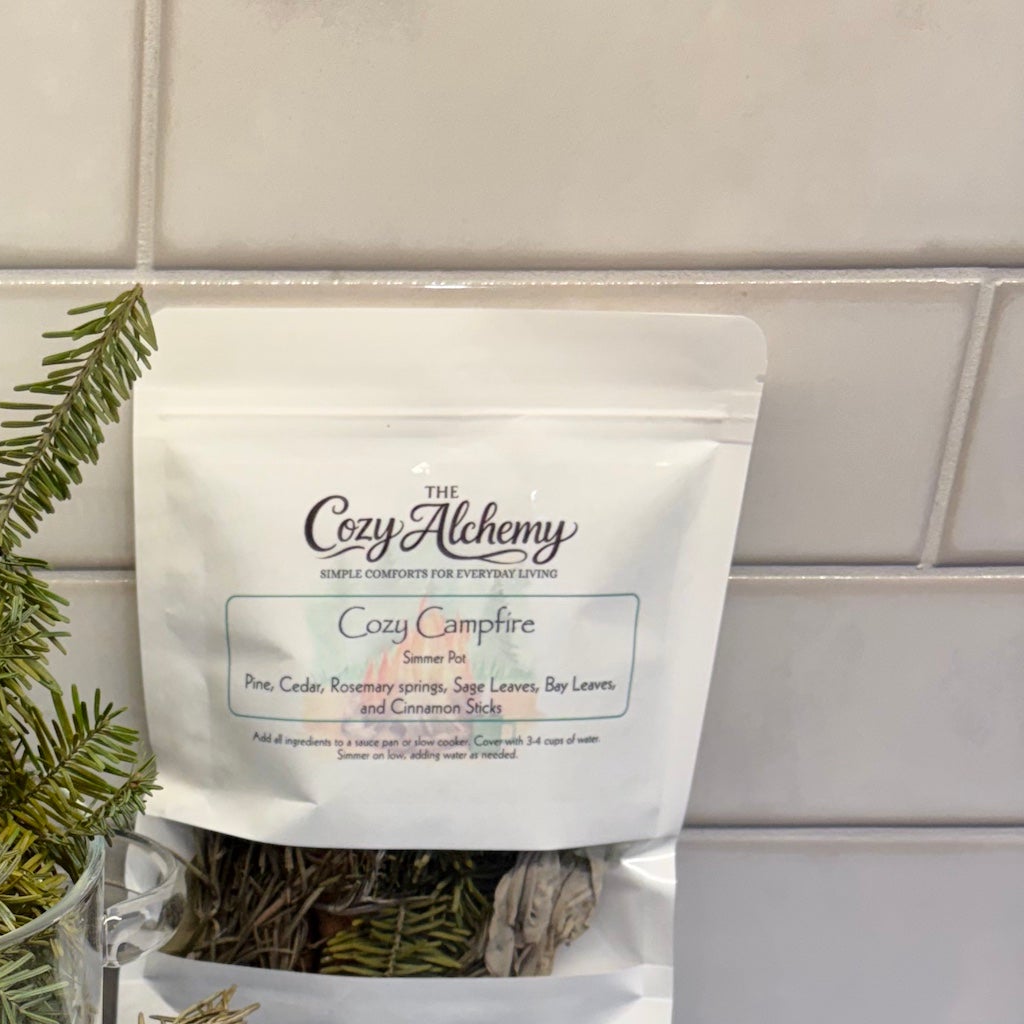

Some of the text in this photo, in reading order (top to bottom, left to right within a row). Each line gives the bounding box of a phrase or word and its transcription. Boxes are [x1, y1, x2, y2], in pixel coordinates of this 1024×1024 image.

[425, 485, 459, 499] THE
[304, 495, 578, 564] Cozy Alchemy
[320, 569, 557, 579] SIMPLE COMFORTS FOR EVERYDAY LIVING
[338, 606, 536, 646] Cozy Campfire
[403, 651, 466, 665] Simmer Pot
[244, 674, 616, 696] Pine, Cedar, Rosemary springs, Sage Leaves, Bay Leaves,
[360, 699, 502, 715] and Cinnamon Sticks
[253, 732, 271, 743] Add
[274, 733, 282, 744] all
[285, 735, 331, 747] ingredients
[334, 739, 343, 747] to
[382, 740, 398, 748] pan
[415, 736, 434, 746] slow
[437, 736, 470, 747] cooker.
[474, 735, 502, 746] Cover
[505, 735, 523, 746] with
[527, 736, 541, 745] 3-4
[544, 738, 564, 746] cups
[566, 733, 576, 745] of
[577, 735, 600, 744] water.
[338, 749, 369, 760] Simmer
[410, 750, 441, 761] adding
[443, 750, 467, 759] water
[481, 749, 518, 759] needed.
